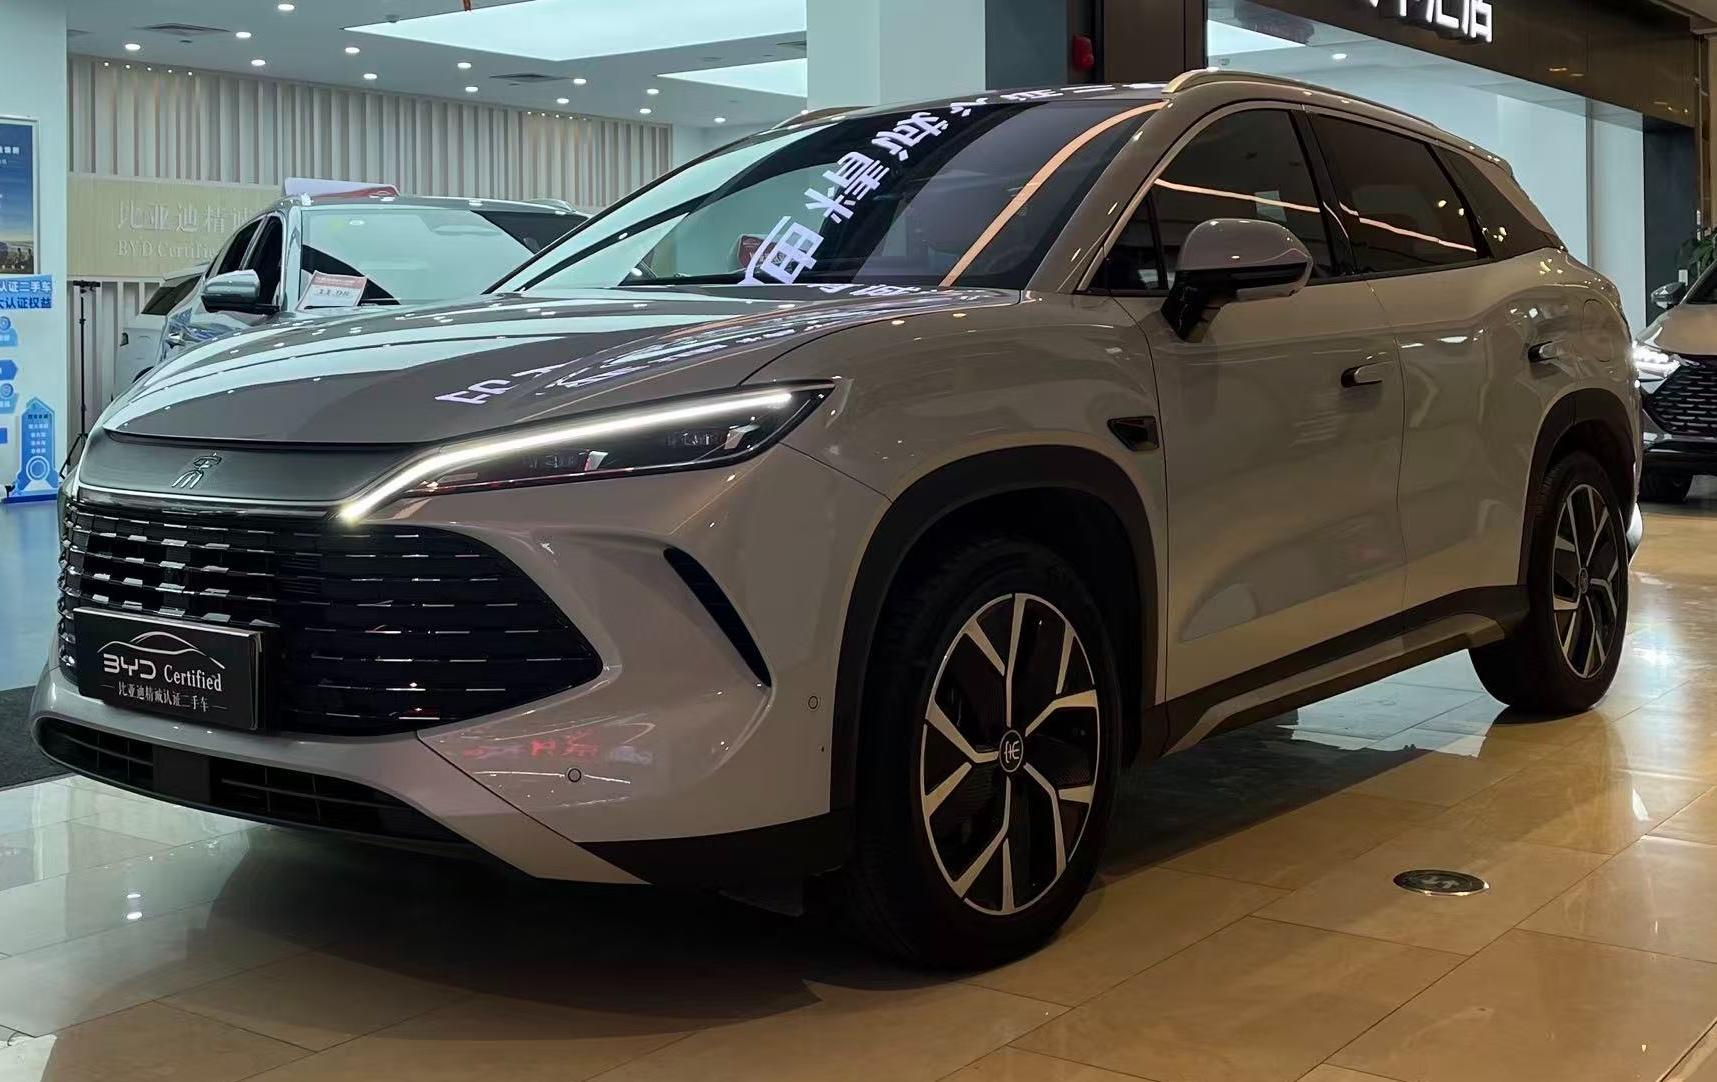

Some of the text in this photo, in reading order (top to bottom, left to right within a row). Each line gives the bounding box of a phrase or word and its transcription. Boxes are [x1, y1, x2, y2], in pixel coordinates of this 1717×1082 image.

[117, 239, 152, 257] BYD
[103, 653, 223, 692] BYD Certified
[118, 681, 209, 712] 比亚迪精诚认证二手车
